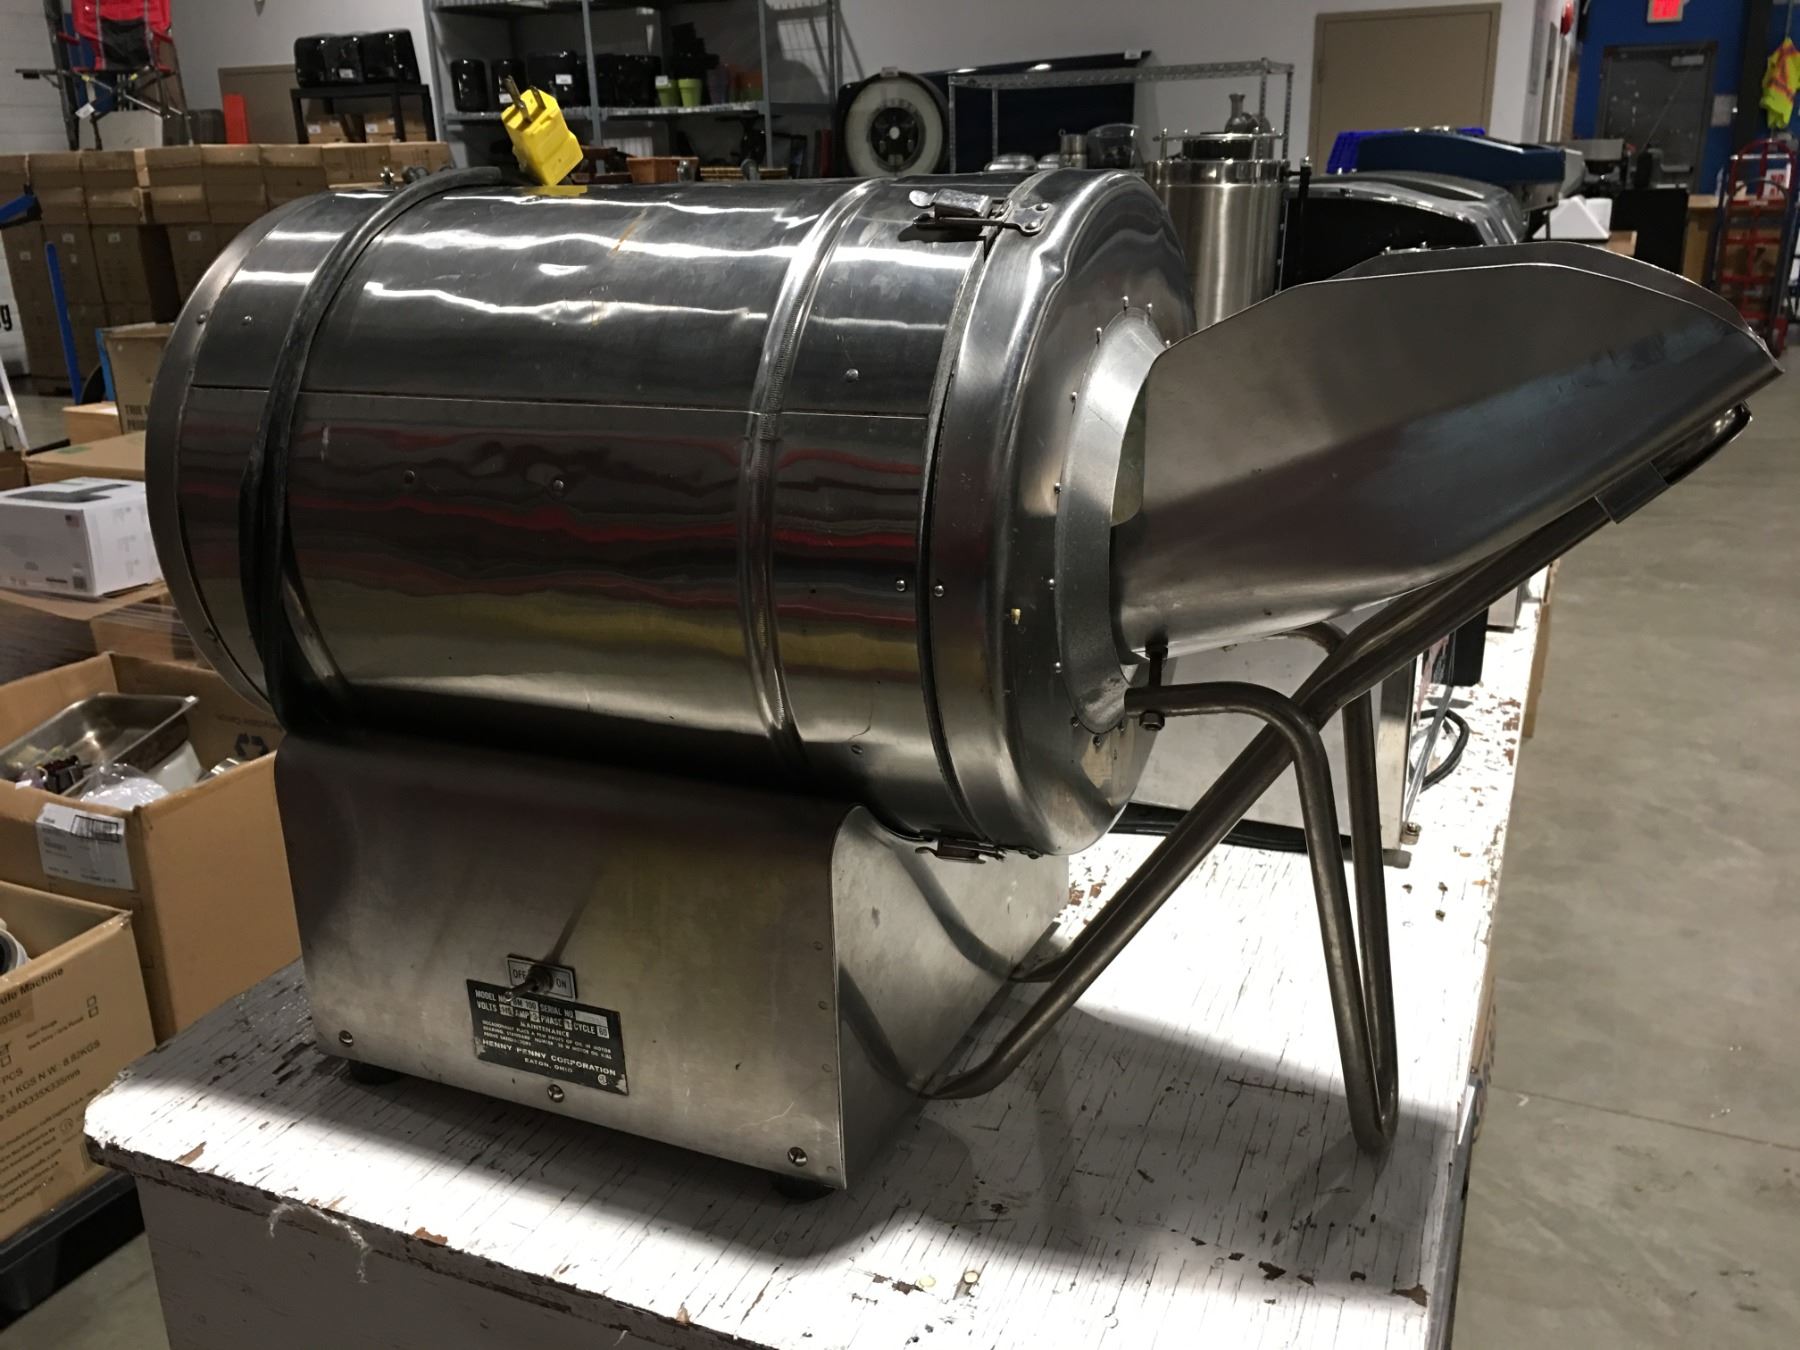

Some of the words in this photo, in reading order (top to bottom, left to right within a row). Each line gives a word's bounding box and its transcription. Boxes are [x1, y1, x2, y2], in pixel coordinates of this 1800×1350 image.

[20, 968, 63, 995] Machine
[513, 969, 527, 980] OFF
[556, 977, 567, 988] ON
[475, 989, 496, 1001] MODEL
[540, 1004, 562, 1016] SERIAL
[477, 1000, 497, 1012] VOLTS
[515, 1009, 529, 1019] AMP
[541, 1015, 562, 1027] PHASE
[573, 1022, 596, 1035] CYCLE
[520, 1021, 570, 1038] MAINTENANCE
[482, 1039, 512, 1051] HENNY
[516, 1047, 546, 1059] PENNY
[550, 1055, 616, 1076] CORPORATION
[524, 1057, 551, 1069] EATON,
[554, 1064, 573, 1073] OHIO
[2, 1068, 23, 1085] PCS
